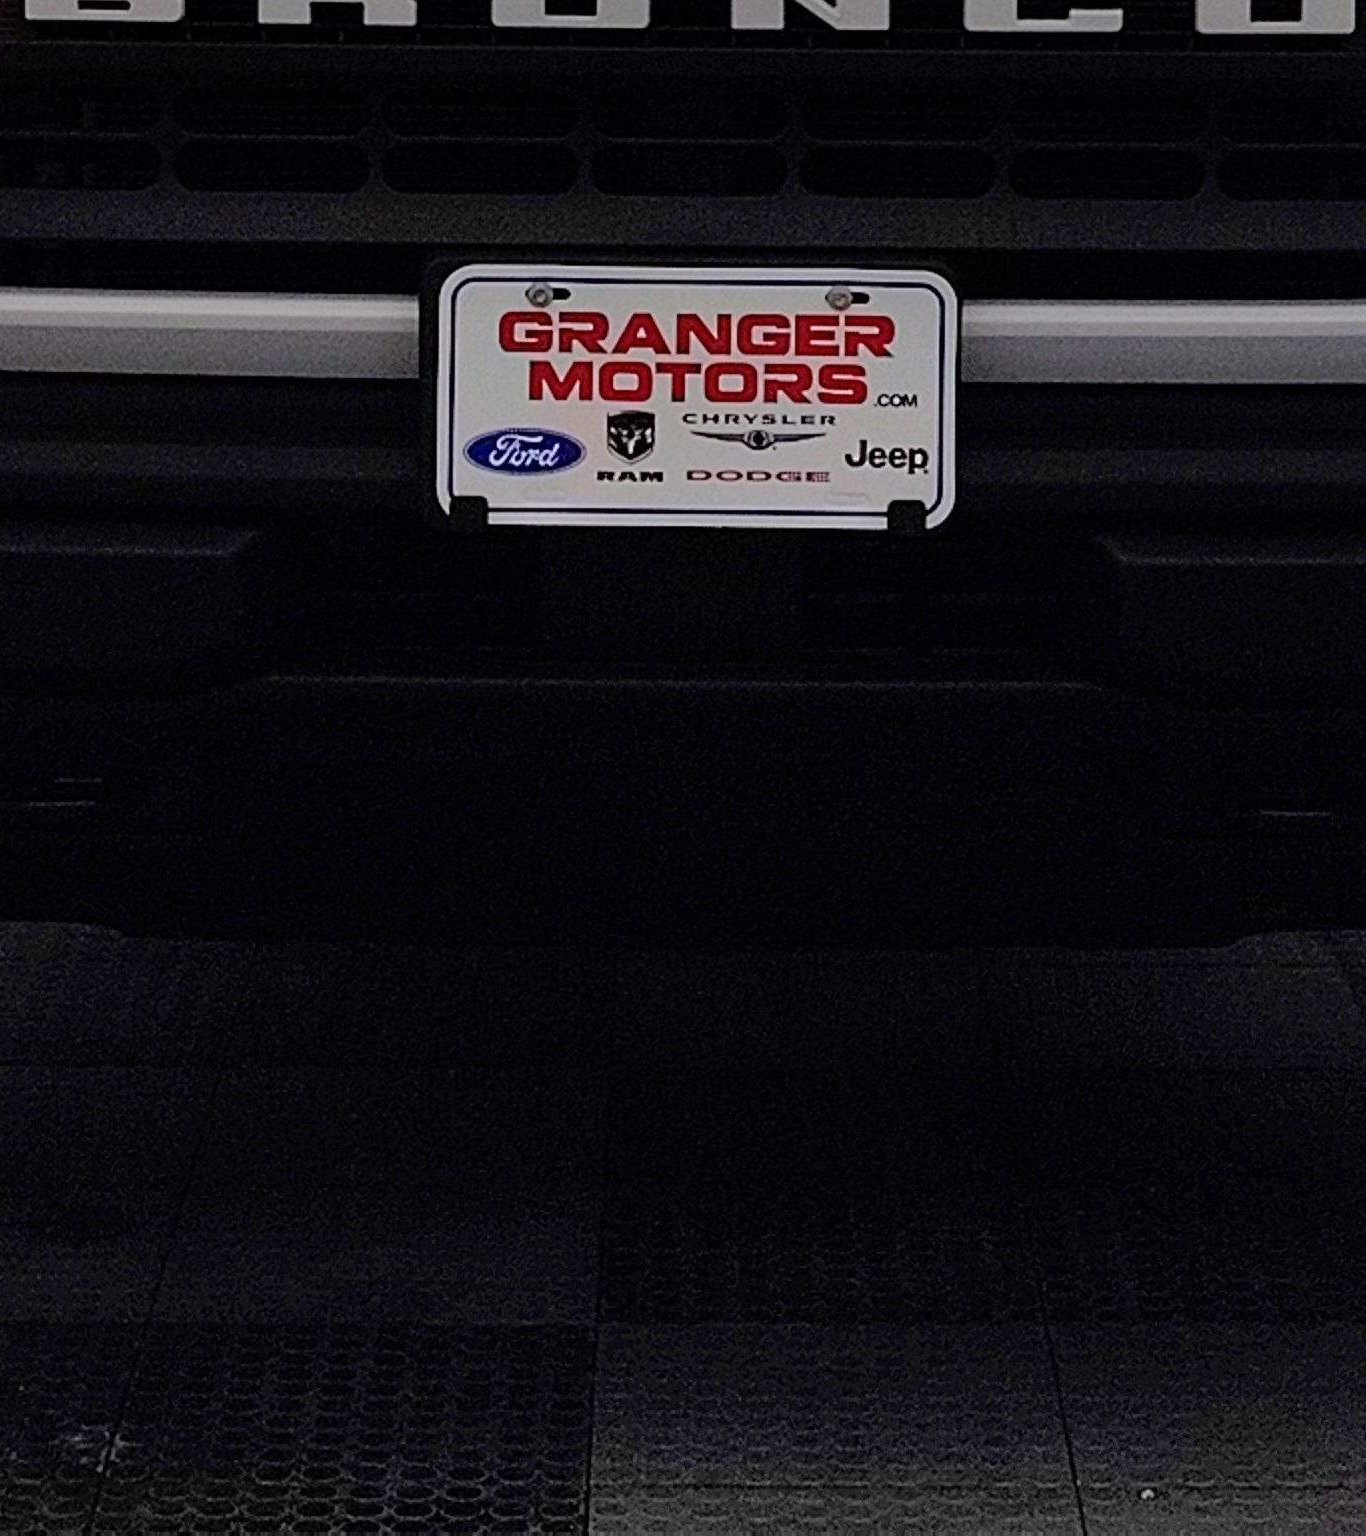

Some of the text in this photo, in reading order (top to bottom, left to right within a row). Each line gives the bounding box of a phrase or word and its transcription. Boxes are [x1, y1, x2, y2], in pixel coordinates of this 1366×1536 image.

[498, 310, 896, 358] GRANGER
[528, 360, 869, 404] MOTORS
[682, 413, 836, 425] CHRYSLER
[488, 434, 561, 468] Ford
[844, 439, 929, 475] Jeep
[596, 471, 664, 483] RAM
[686, 469, 831, 483] DODGE
